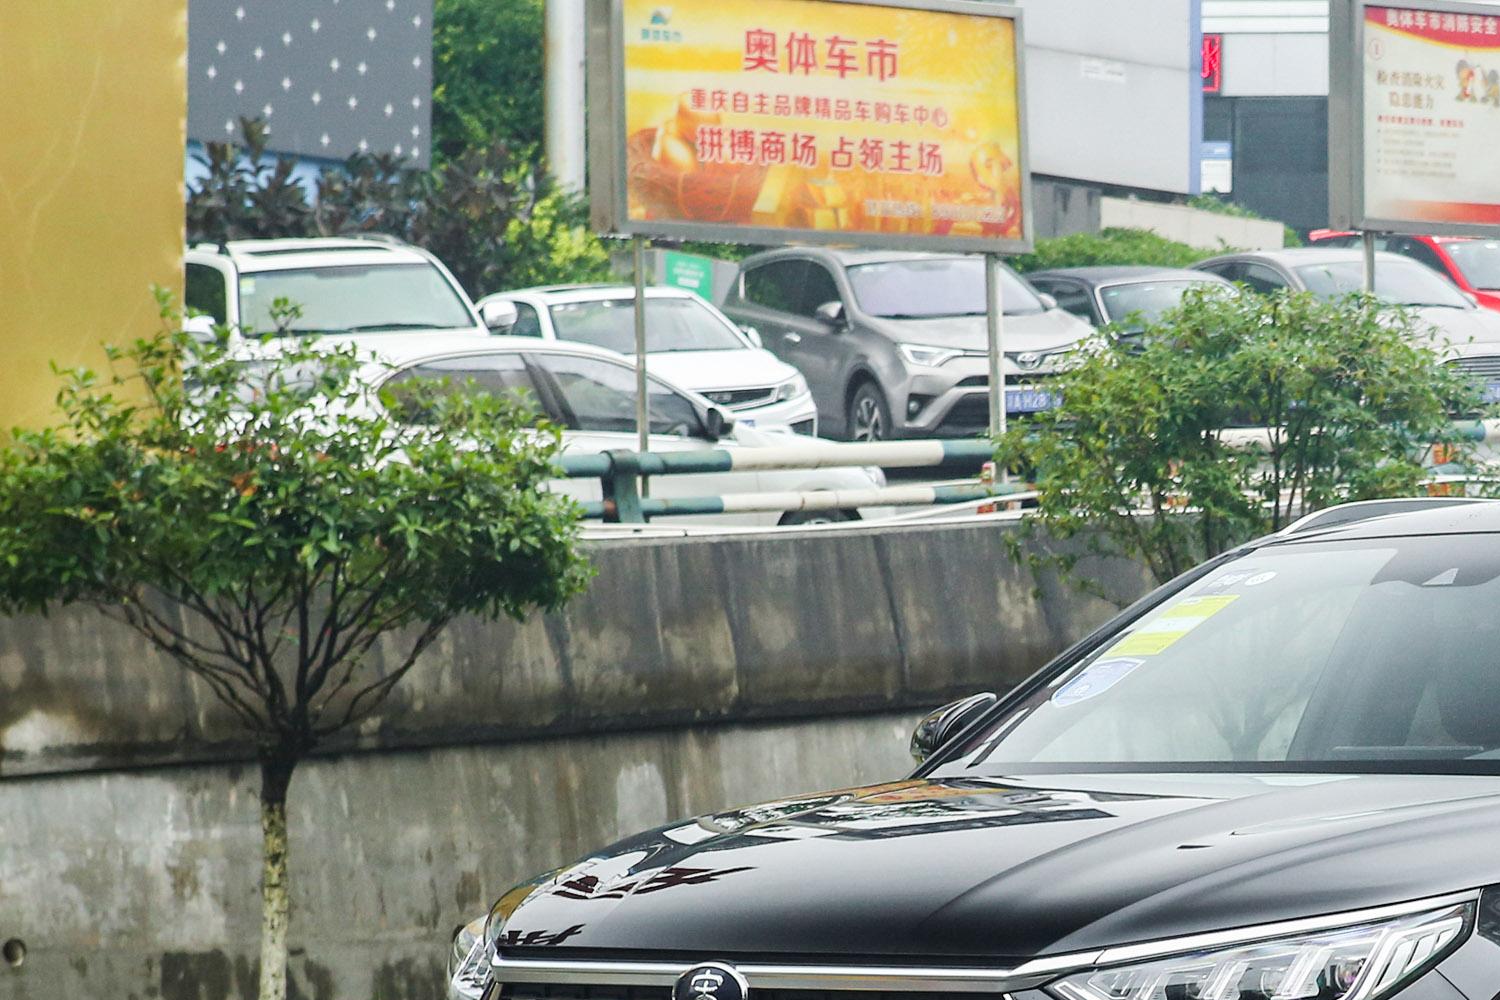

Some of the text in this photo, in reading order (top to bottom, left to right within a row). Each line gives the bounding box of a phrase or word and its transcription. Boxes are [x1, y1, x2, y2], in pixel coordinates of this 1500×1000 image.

[744, 28, 899, 82] 奥体车市
[690, 88, 950, 129] 重庆自主品牌精品车购车中心
[831, 136, 945, 177] 占领主场
